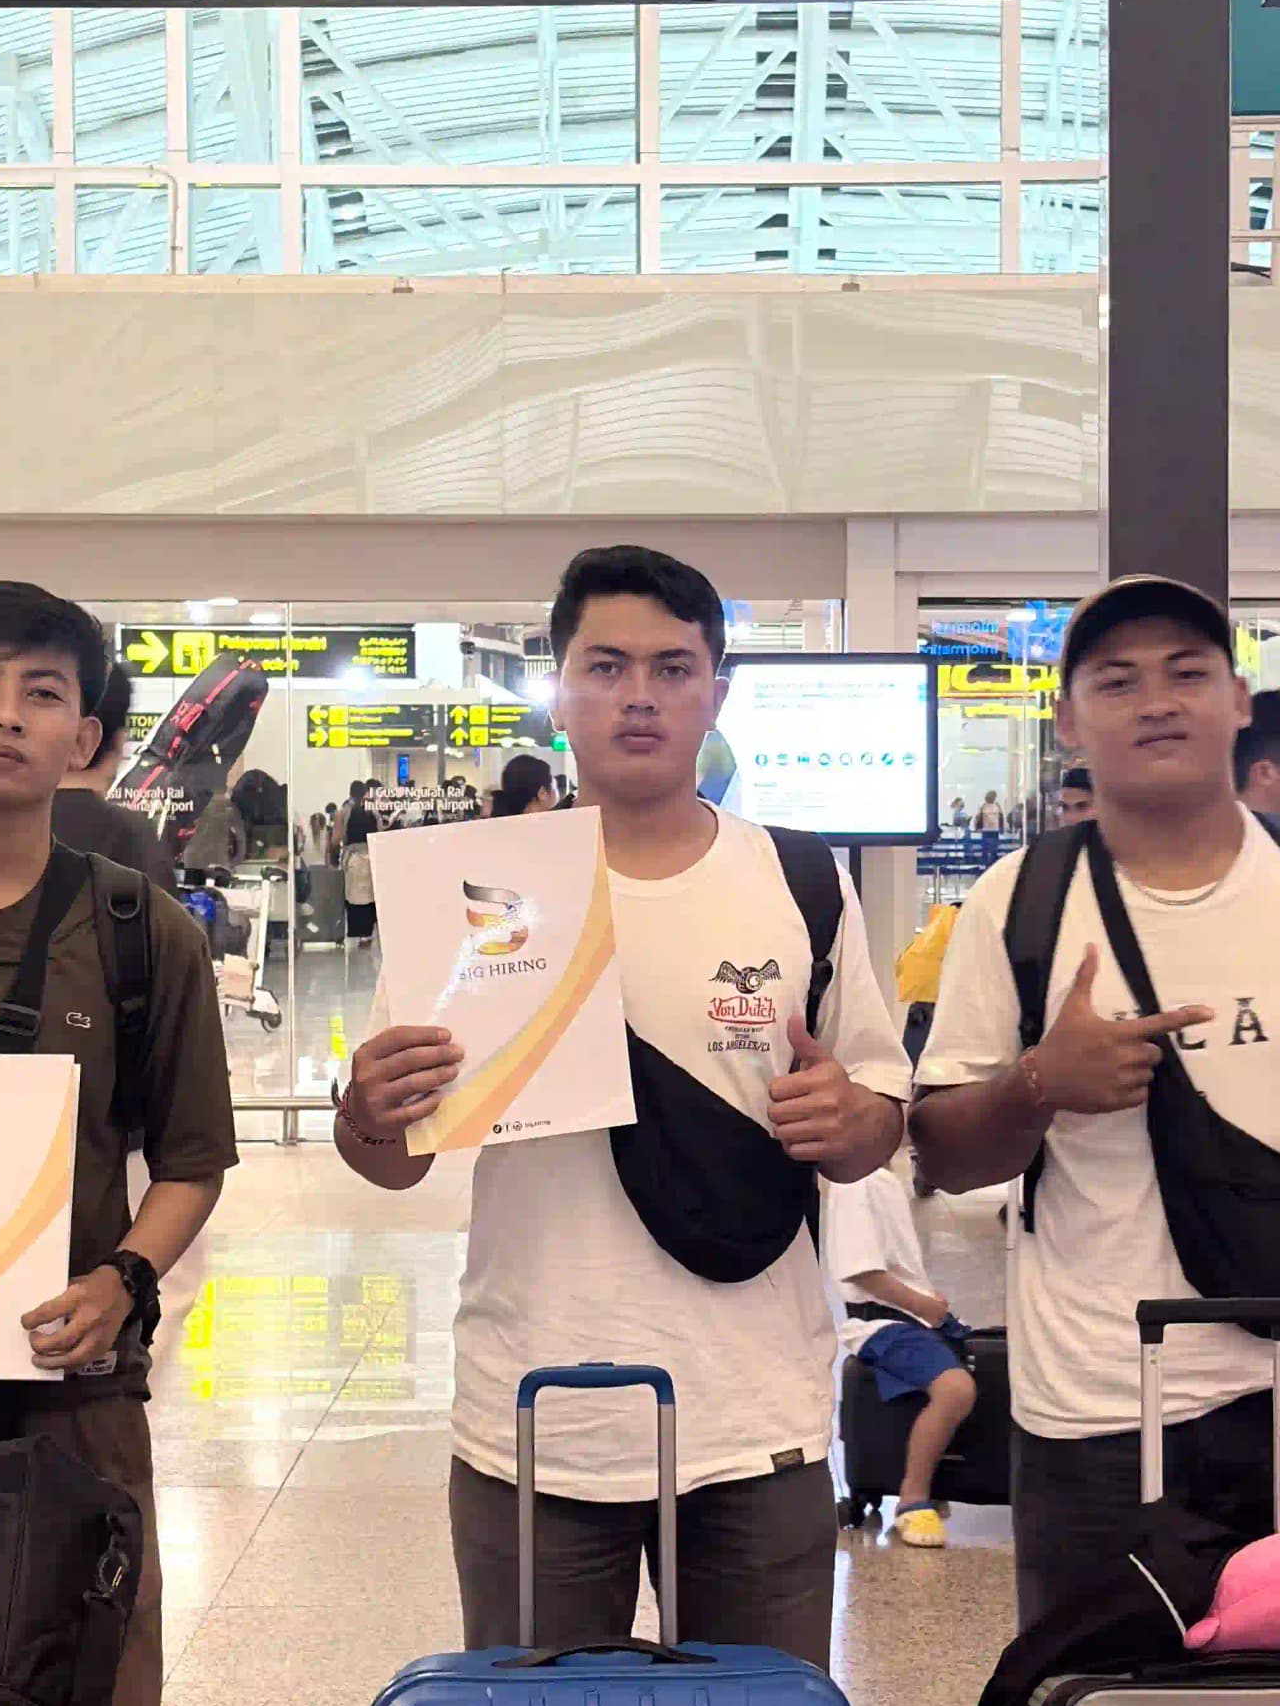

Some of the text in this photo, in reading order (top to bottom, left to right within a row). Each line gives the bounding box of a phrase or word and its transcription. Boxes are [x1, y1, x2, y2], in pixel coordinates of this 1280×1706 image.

[405, 787, 444, 802] Ngurah
[446, 786, 465, 799] Rai
[364, 799, 475, 814] International Airport
[488, 957, 548, 978] HIRING
[707, 1041, 723, 1053] LOS
